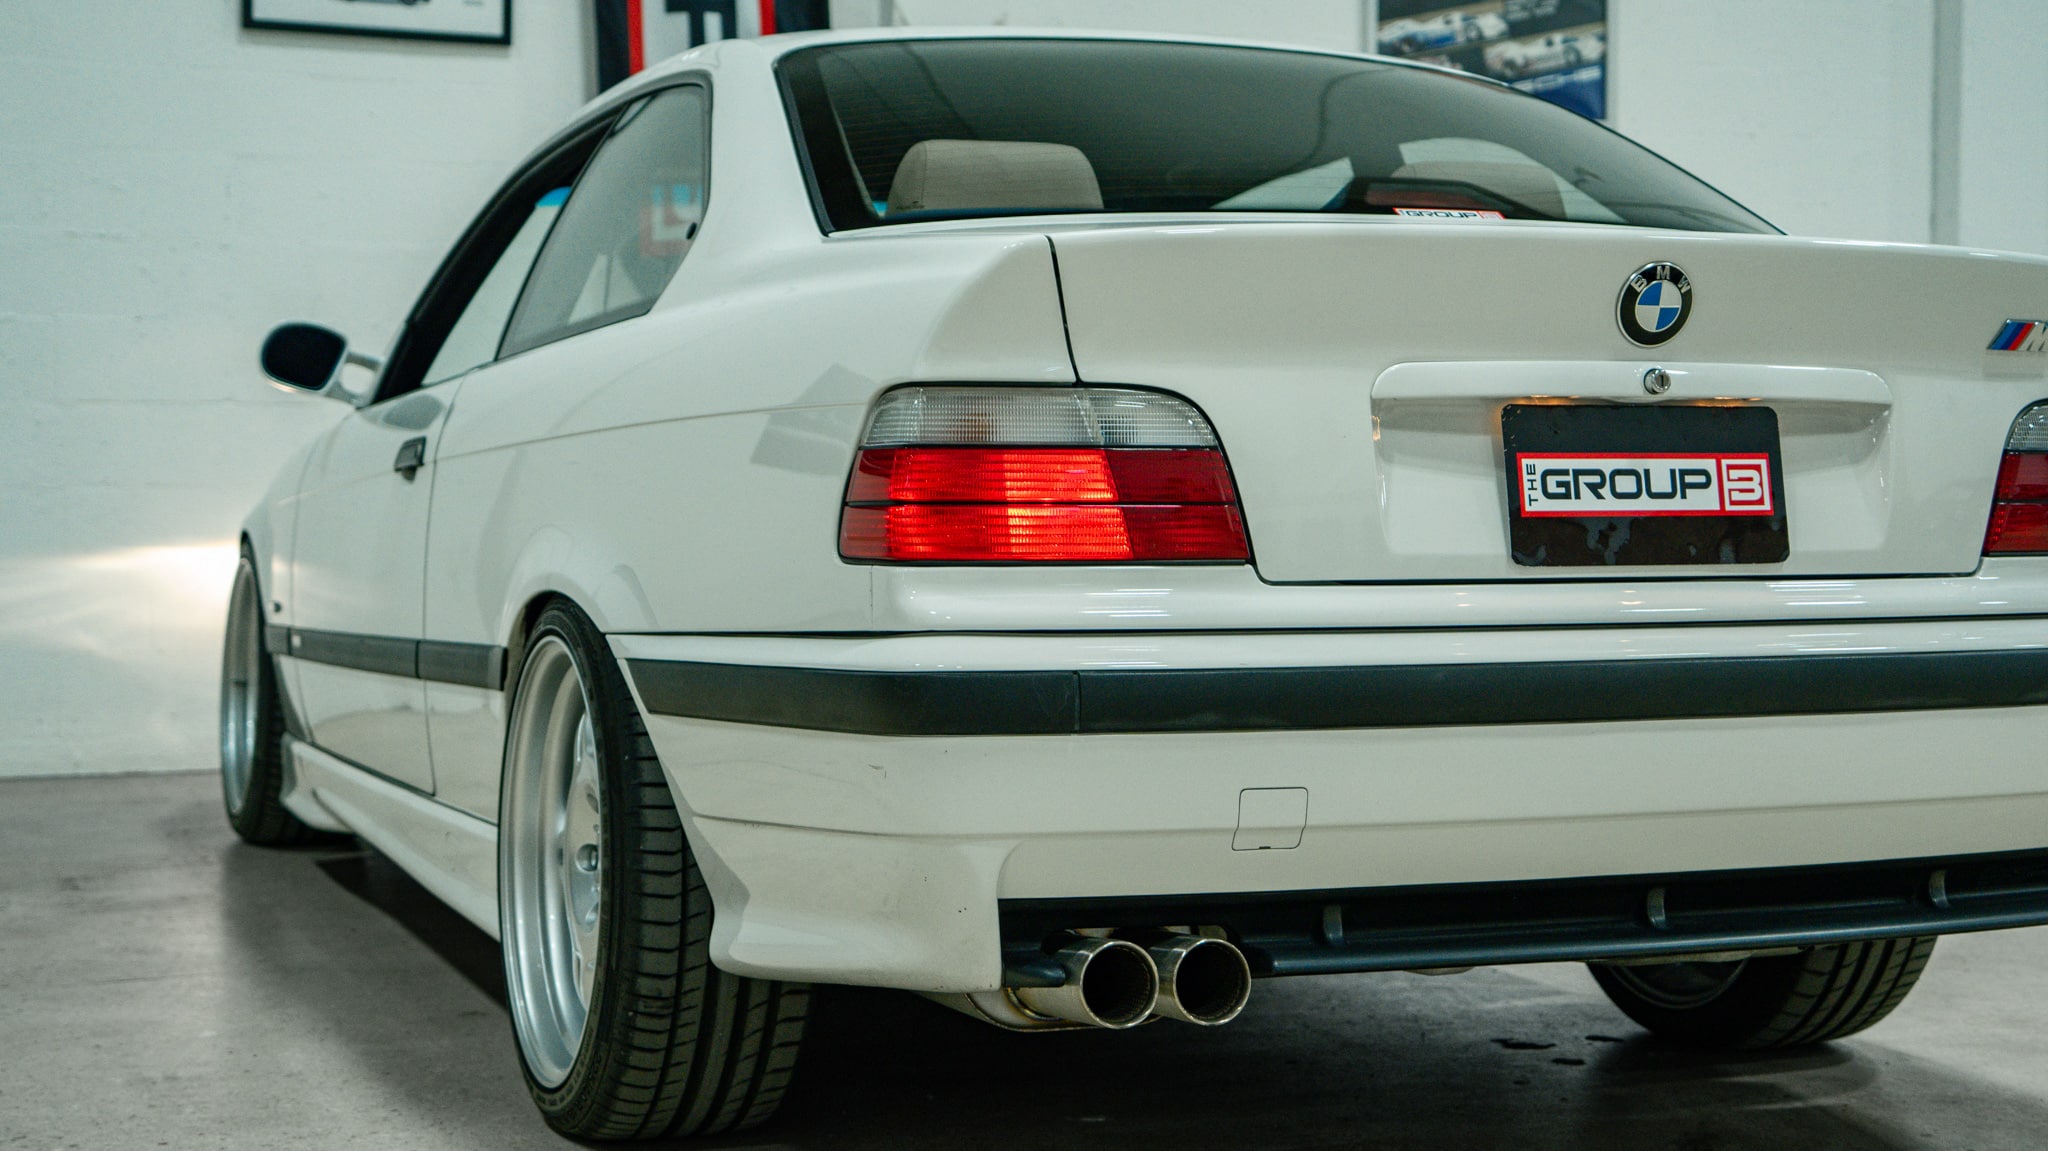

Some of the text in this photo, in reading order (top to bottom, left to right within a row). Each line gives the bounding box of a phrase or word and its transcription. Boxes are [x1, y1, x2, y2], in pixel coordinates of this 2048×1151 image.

[1405, 210, 1478, 218] GROUP
[1630, 265, 1691, 294] BMW
[1525, 463, 1763, 506] THE GROUP 3
